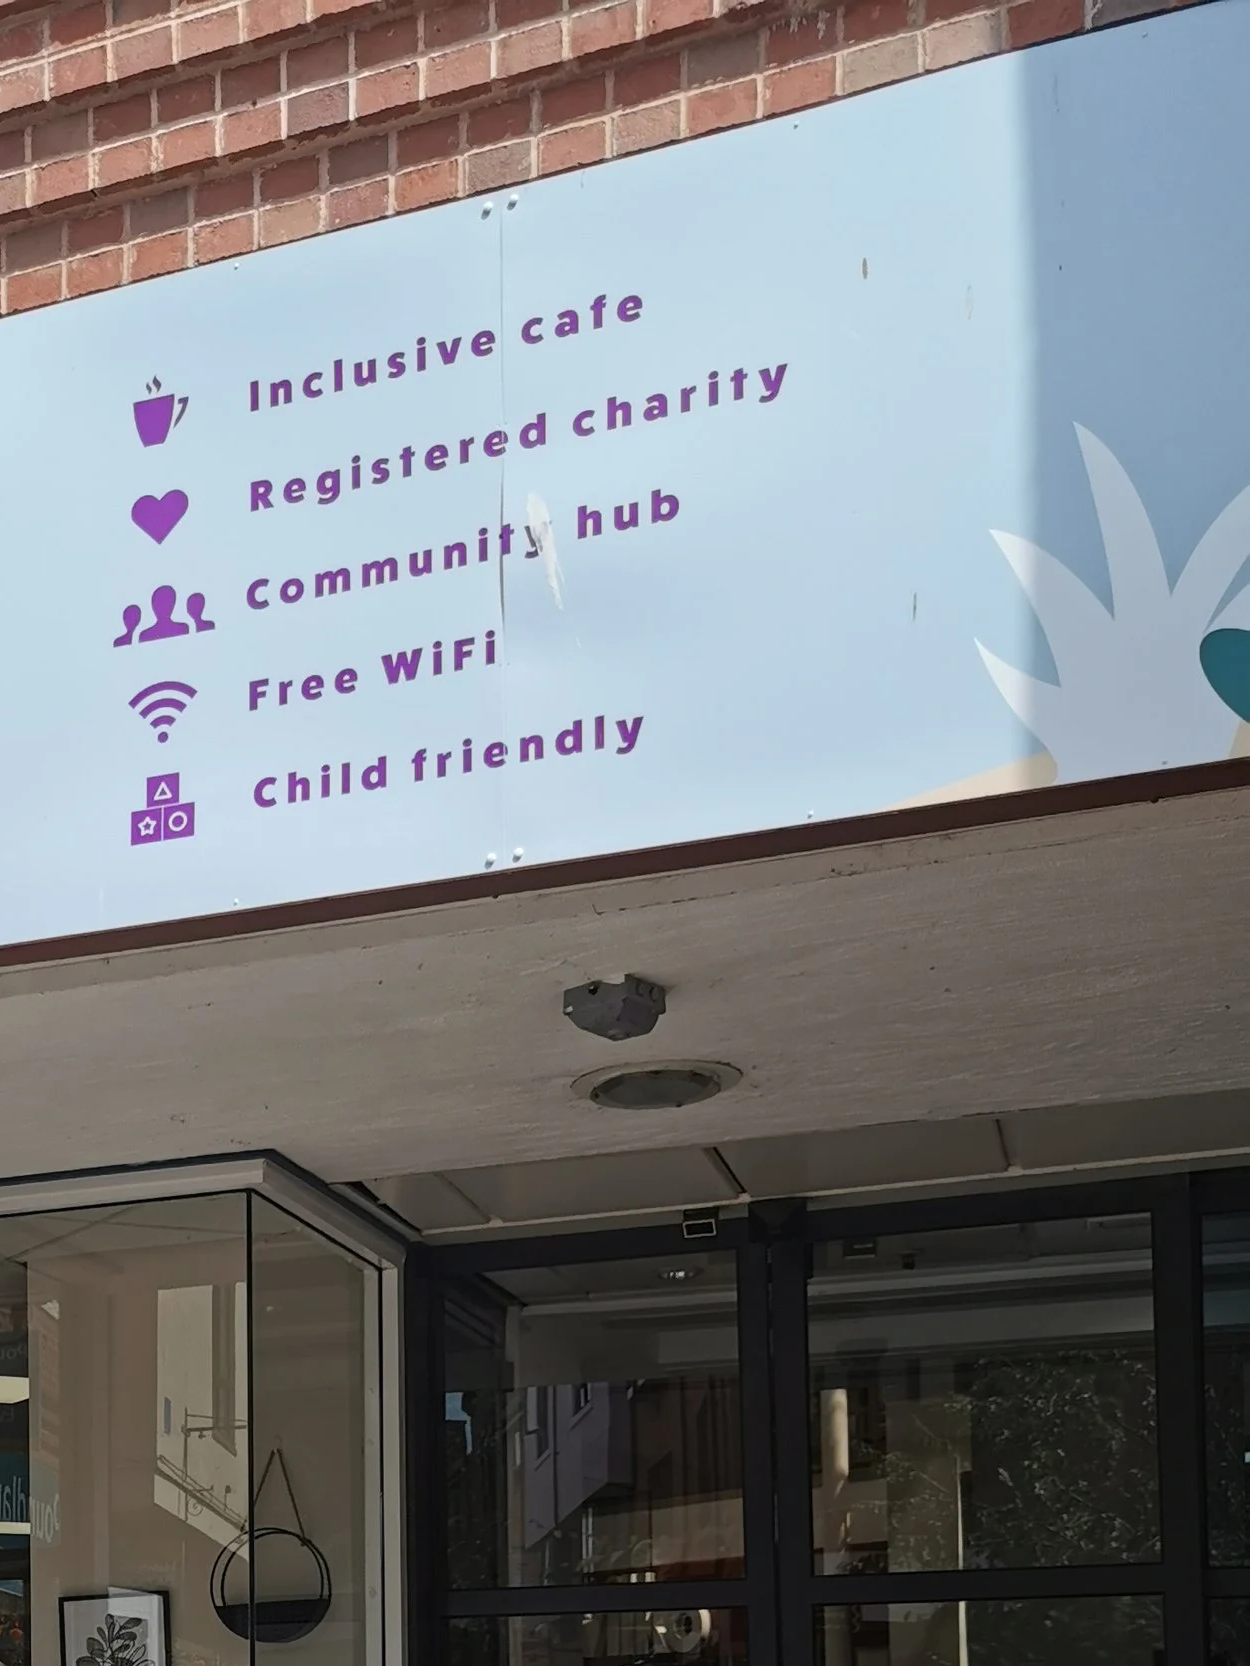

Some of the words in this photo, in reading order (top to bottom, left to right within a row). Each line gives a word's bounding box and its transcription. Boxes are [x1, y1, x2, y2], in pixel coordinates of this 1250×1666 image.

[249, 330, 496, 412] Inclusive
[521, 294, 643, 345] cafe
[250, 412, 546, 512] Registered
[572, 363, 788, 437] charity
[246, 521, 553, 610] Community
[577, 488, 680, 540] hub
[249, 668, 358, 711] Free
[380, 629, 497, 685] WiFi
[253, 755, 387, 808] Child
[411, 715, 644, 782] friendly
